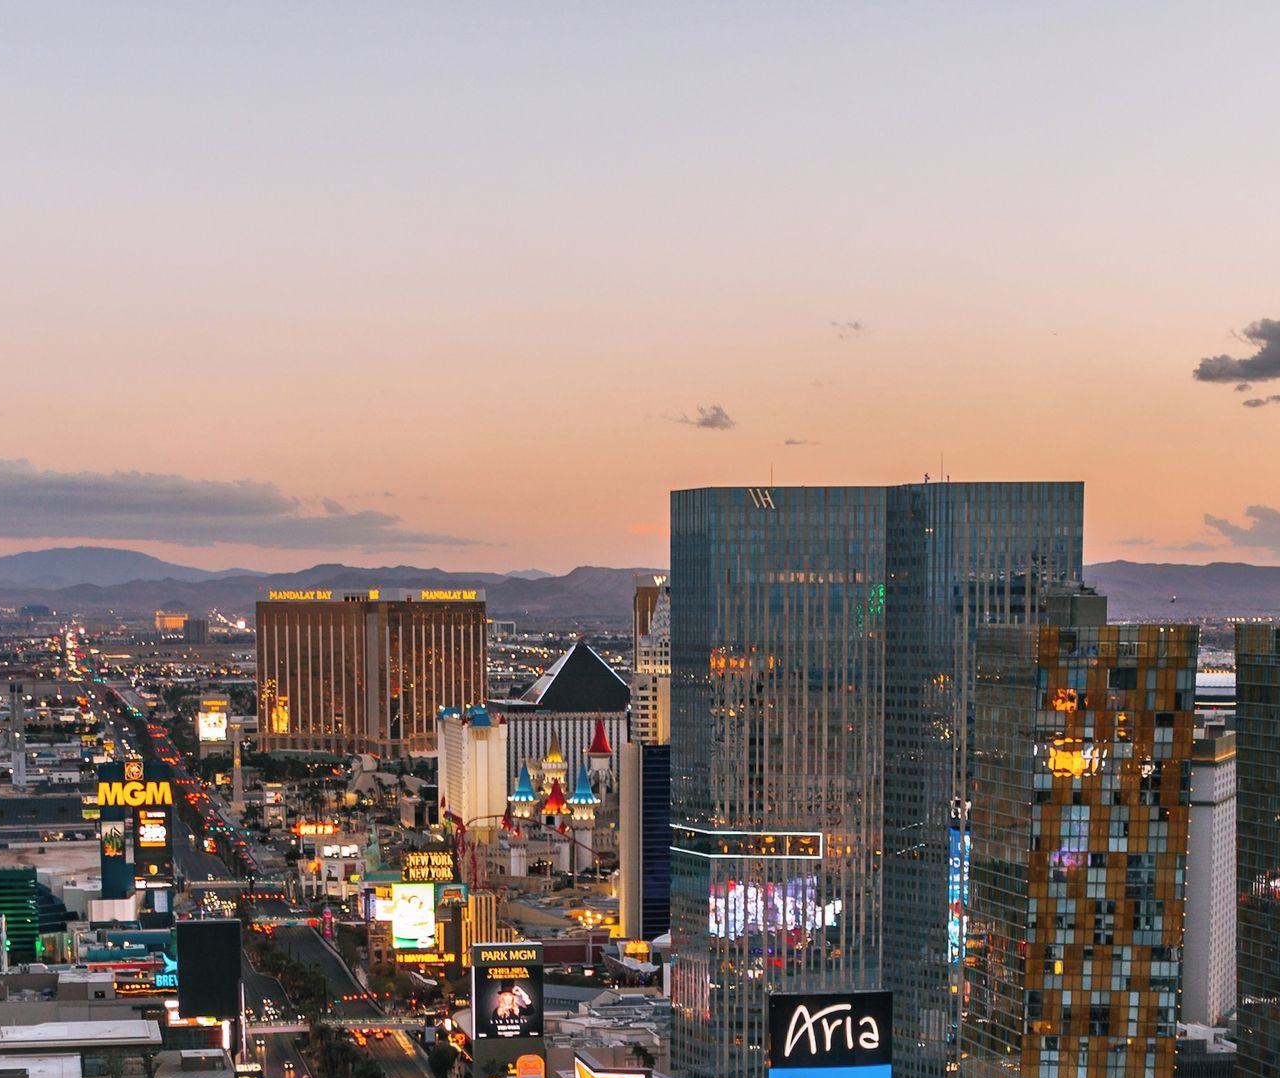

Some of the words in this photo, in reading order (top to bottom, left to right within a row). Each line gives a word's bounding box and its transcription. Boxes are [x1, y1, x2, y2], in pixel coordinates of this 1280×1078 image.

[270, 590, 315, 600] MANDALAY
[316, 590, 332, 600] BAY
[421, 590, 461, 600] MANDALAY
[462, 590, 477, 600] BAY
[97, 781, 173, 806] MGM
[409, 855, 429, 867] NEW
[430, 855, 454, 867] YORK
[409, 867, 429, 879] NEW
[430, 867, 454, 879] YORK
[481, 950, 508, 961] PARK
[509, 949, 537, 960] MGM
[784, 1003, 880, 1058] Aria
[235, 1063, 262, 1072] BLVD
